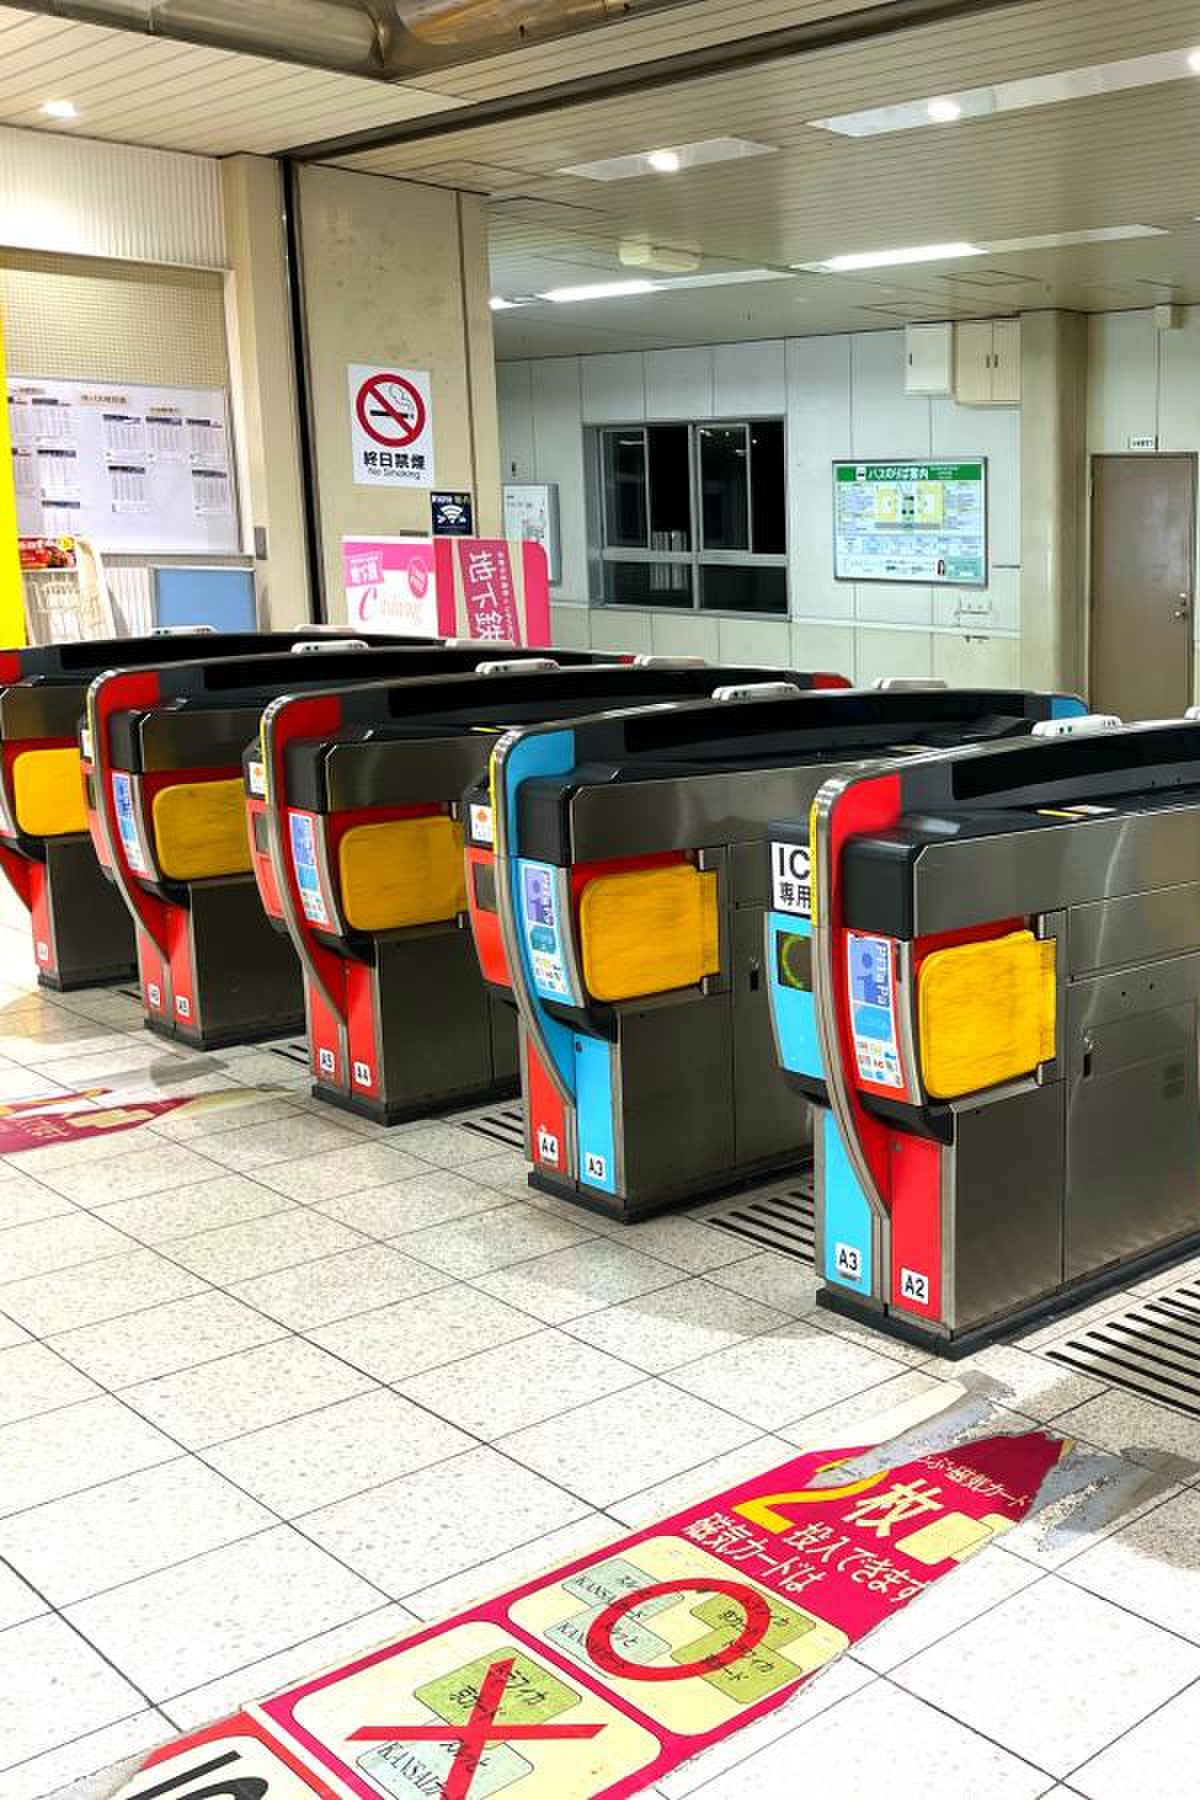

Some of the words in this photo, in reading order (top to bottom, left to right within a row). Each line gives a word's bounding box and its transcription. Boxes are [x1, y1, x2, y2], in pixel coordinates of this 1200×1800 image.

[363, 450, 426, 469] 終日禁煙
[778, 846, 810, 881] IC
[780, 882, 811, 909] 専用
[588, 1157, 603, 1177] A3
[839, 1248, 858, 1271] A3
[905, 1275, 925, 1299] A2
[681, 1512, 828, 1594] 磁気カードは
[783, 1521, 930, 1603] 投入できます
